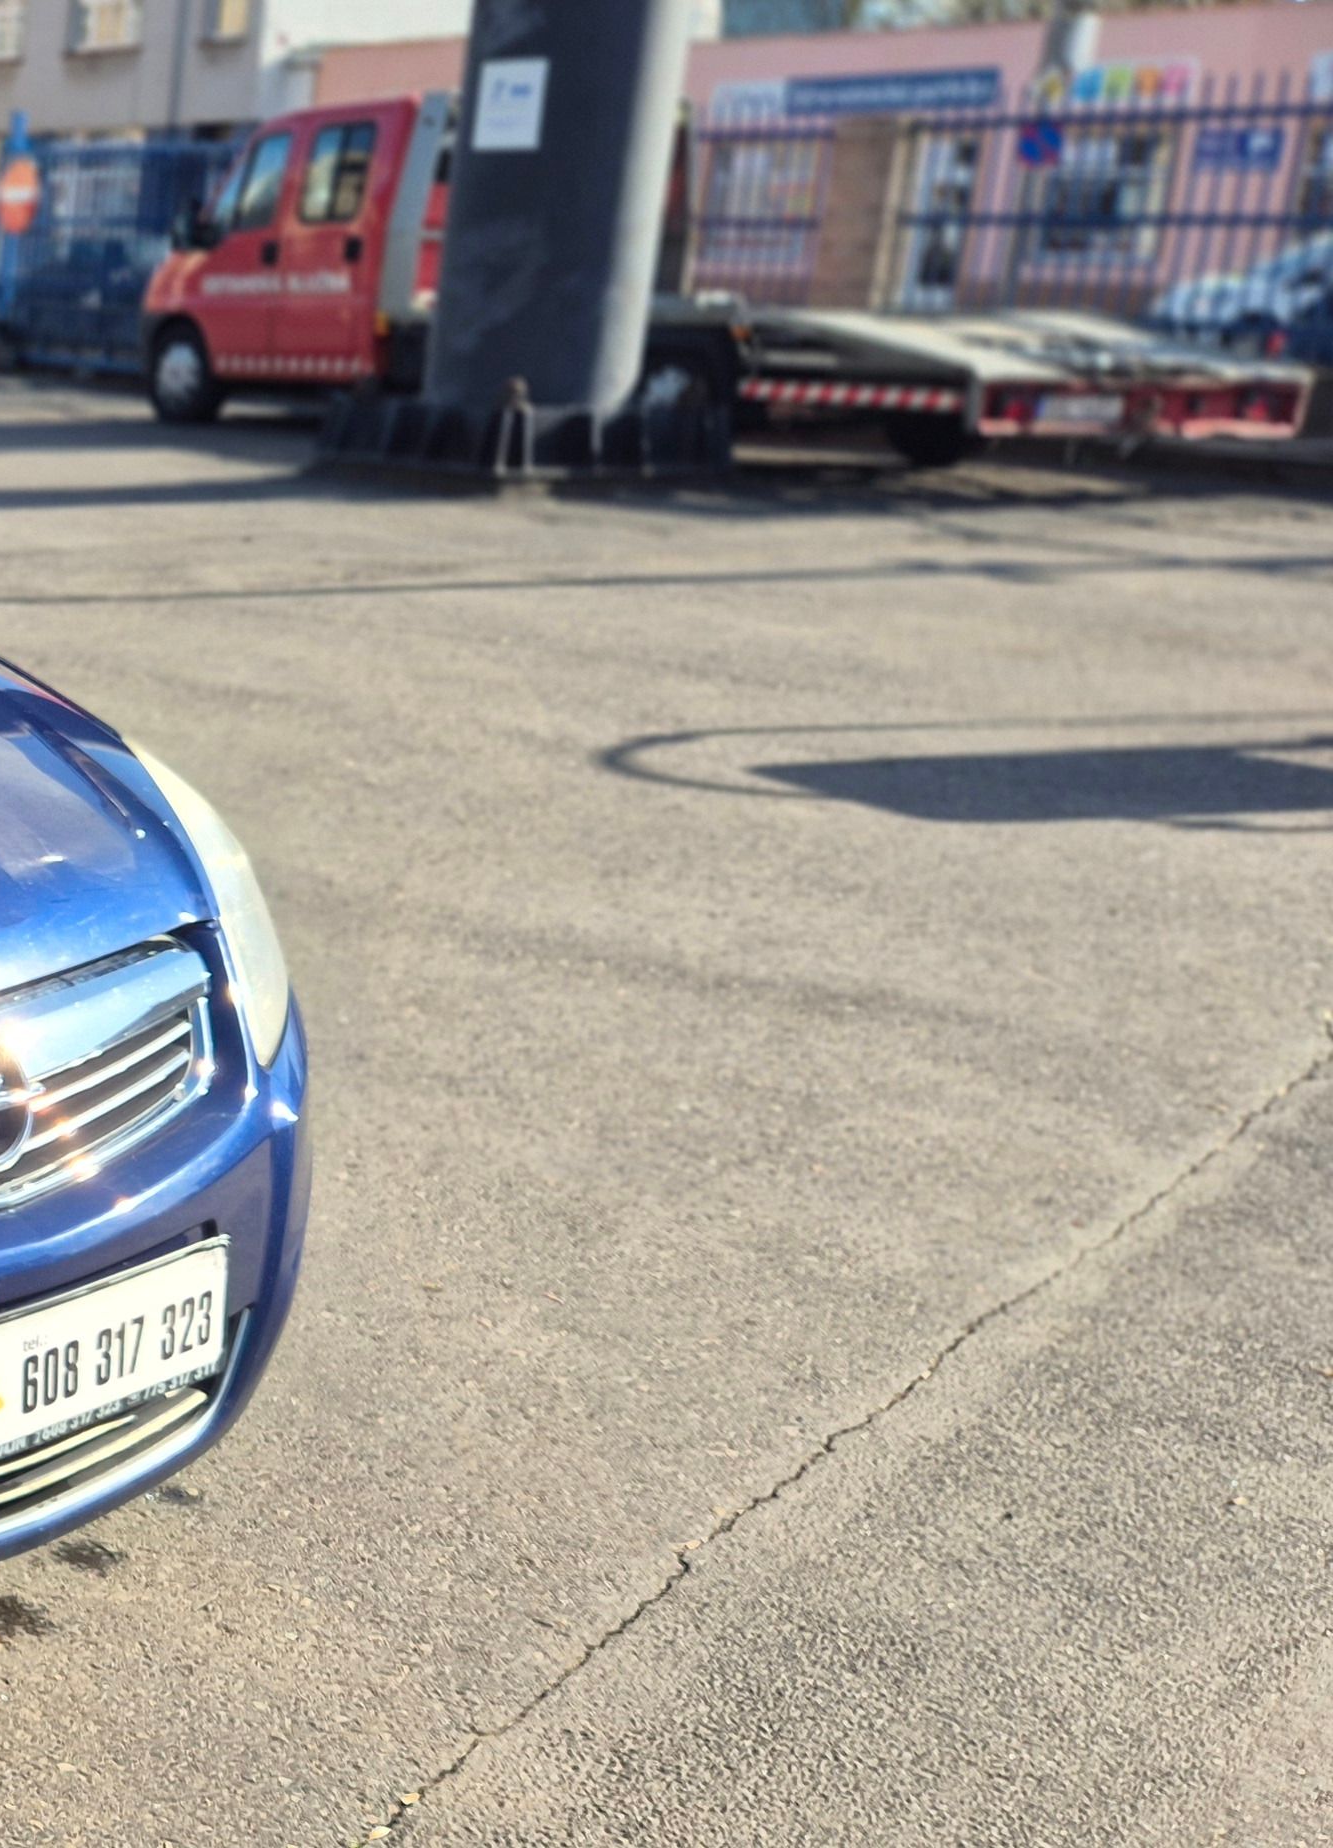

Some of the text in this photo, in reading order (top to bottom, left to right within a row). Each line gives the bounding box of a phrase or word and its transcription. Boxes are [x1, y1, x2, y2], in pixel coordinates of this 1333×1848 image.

[21, 1290, 213, 1415] 608 317 323
